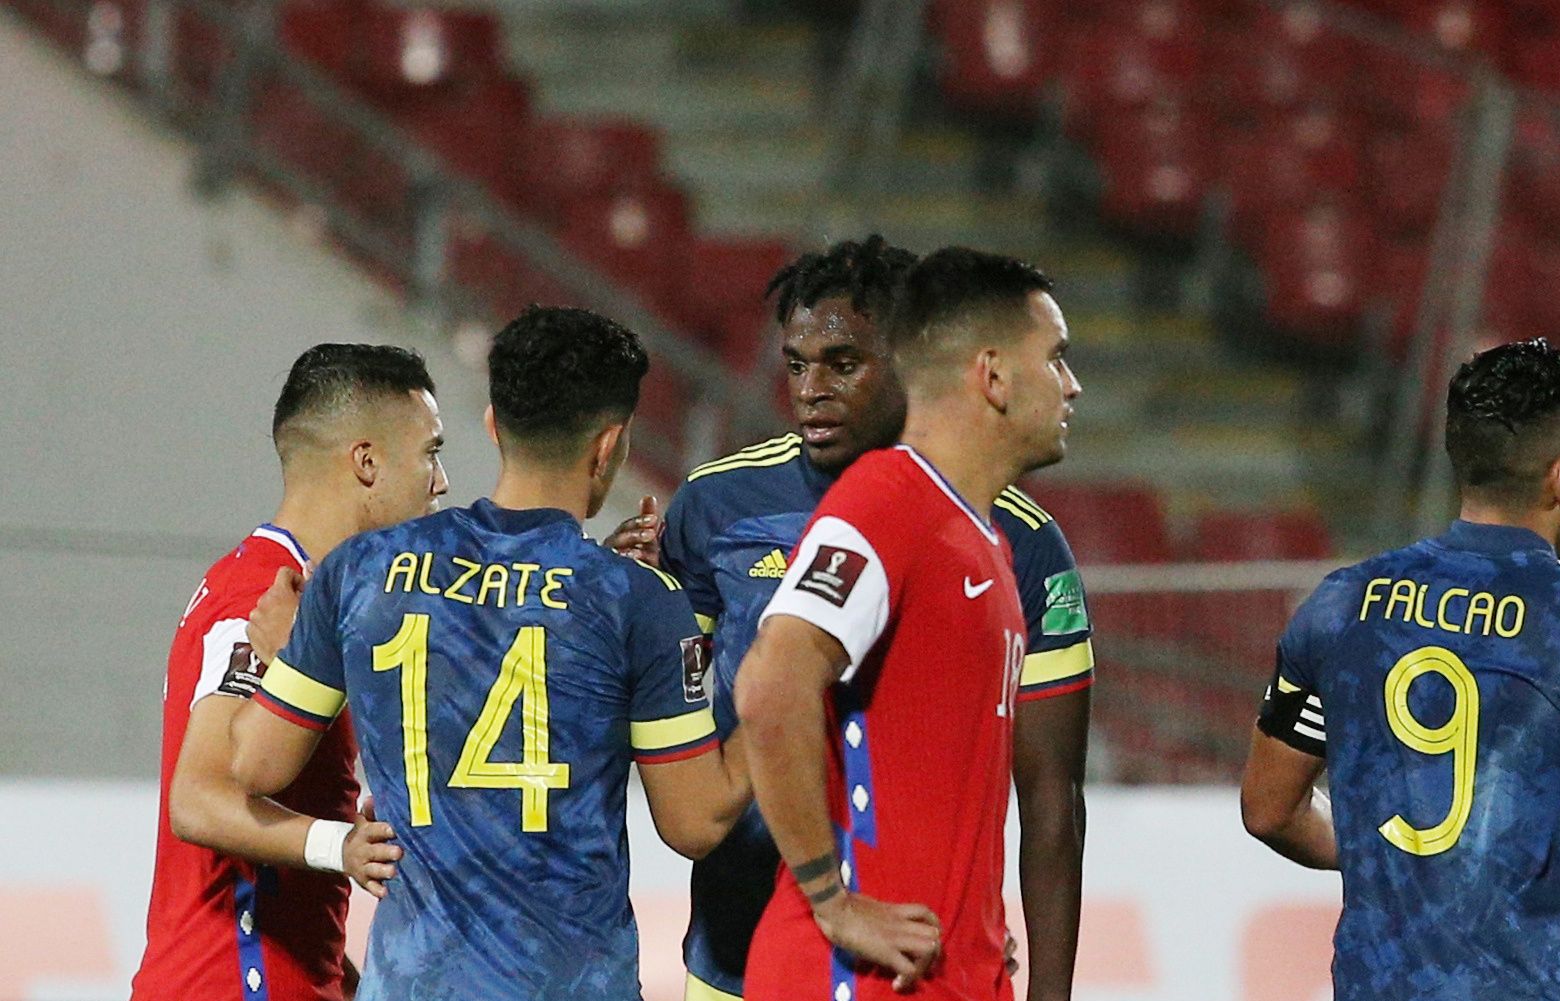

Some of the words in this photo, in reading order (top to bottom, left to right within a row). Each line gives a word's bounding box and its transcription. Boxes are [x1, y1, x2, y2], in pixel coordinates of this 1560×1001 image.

[384, 552, 573, 609] ALZATE
[748, 567, 785, 578] adida
[1359, 578, 1526, 638] FALCAO
[372, 613, 570, 833] 14
[1378, 645, 1480, 856] 9
